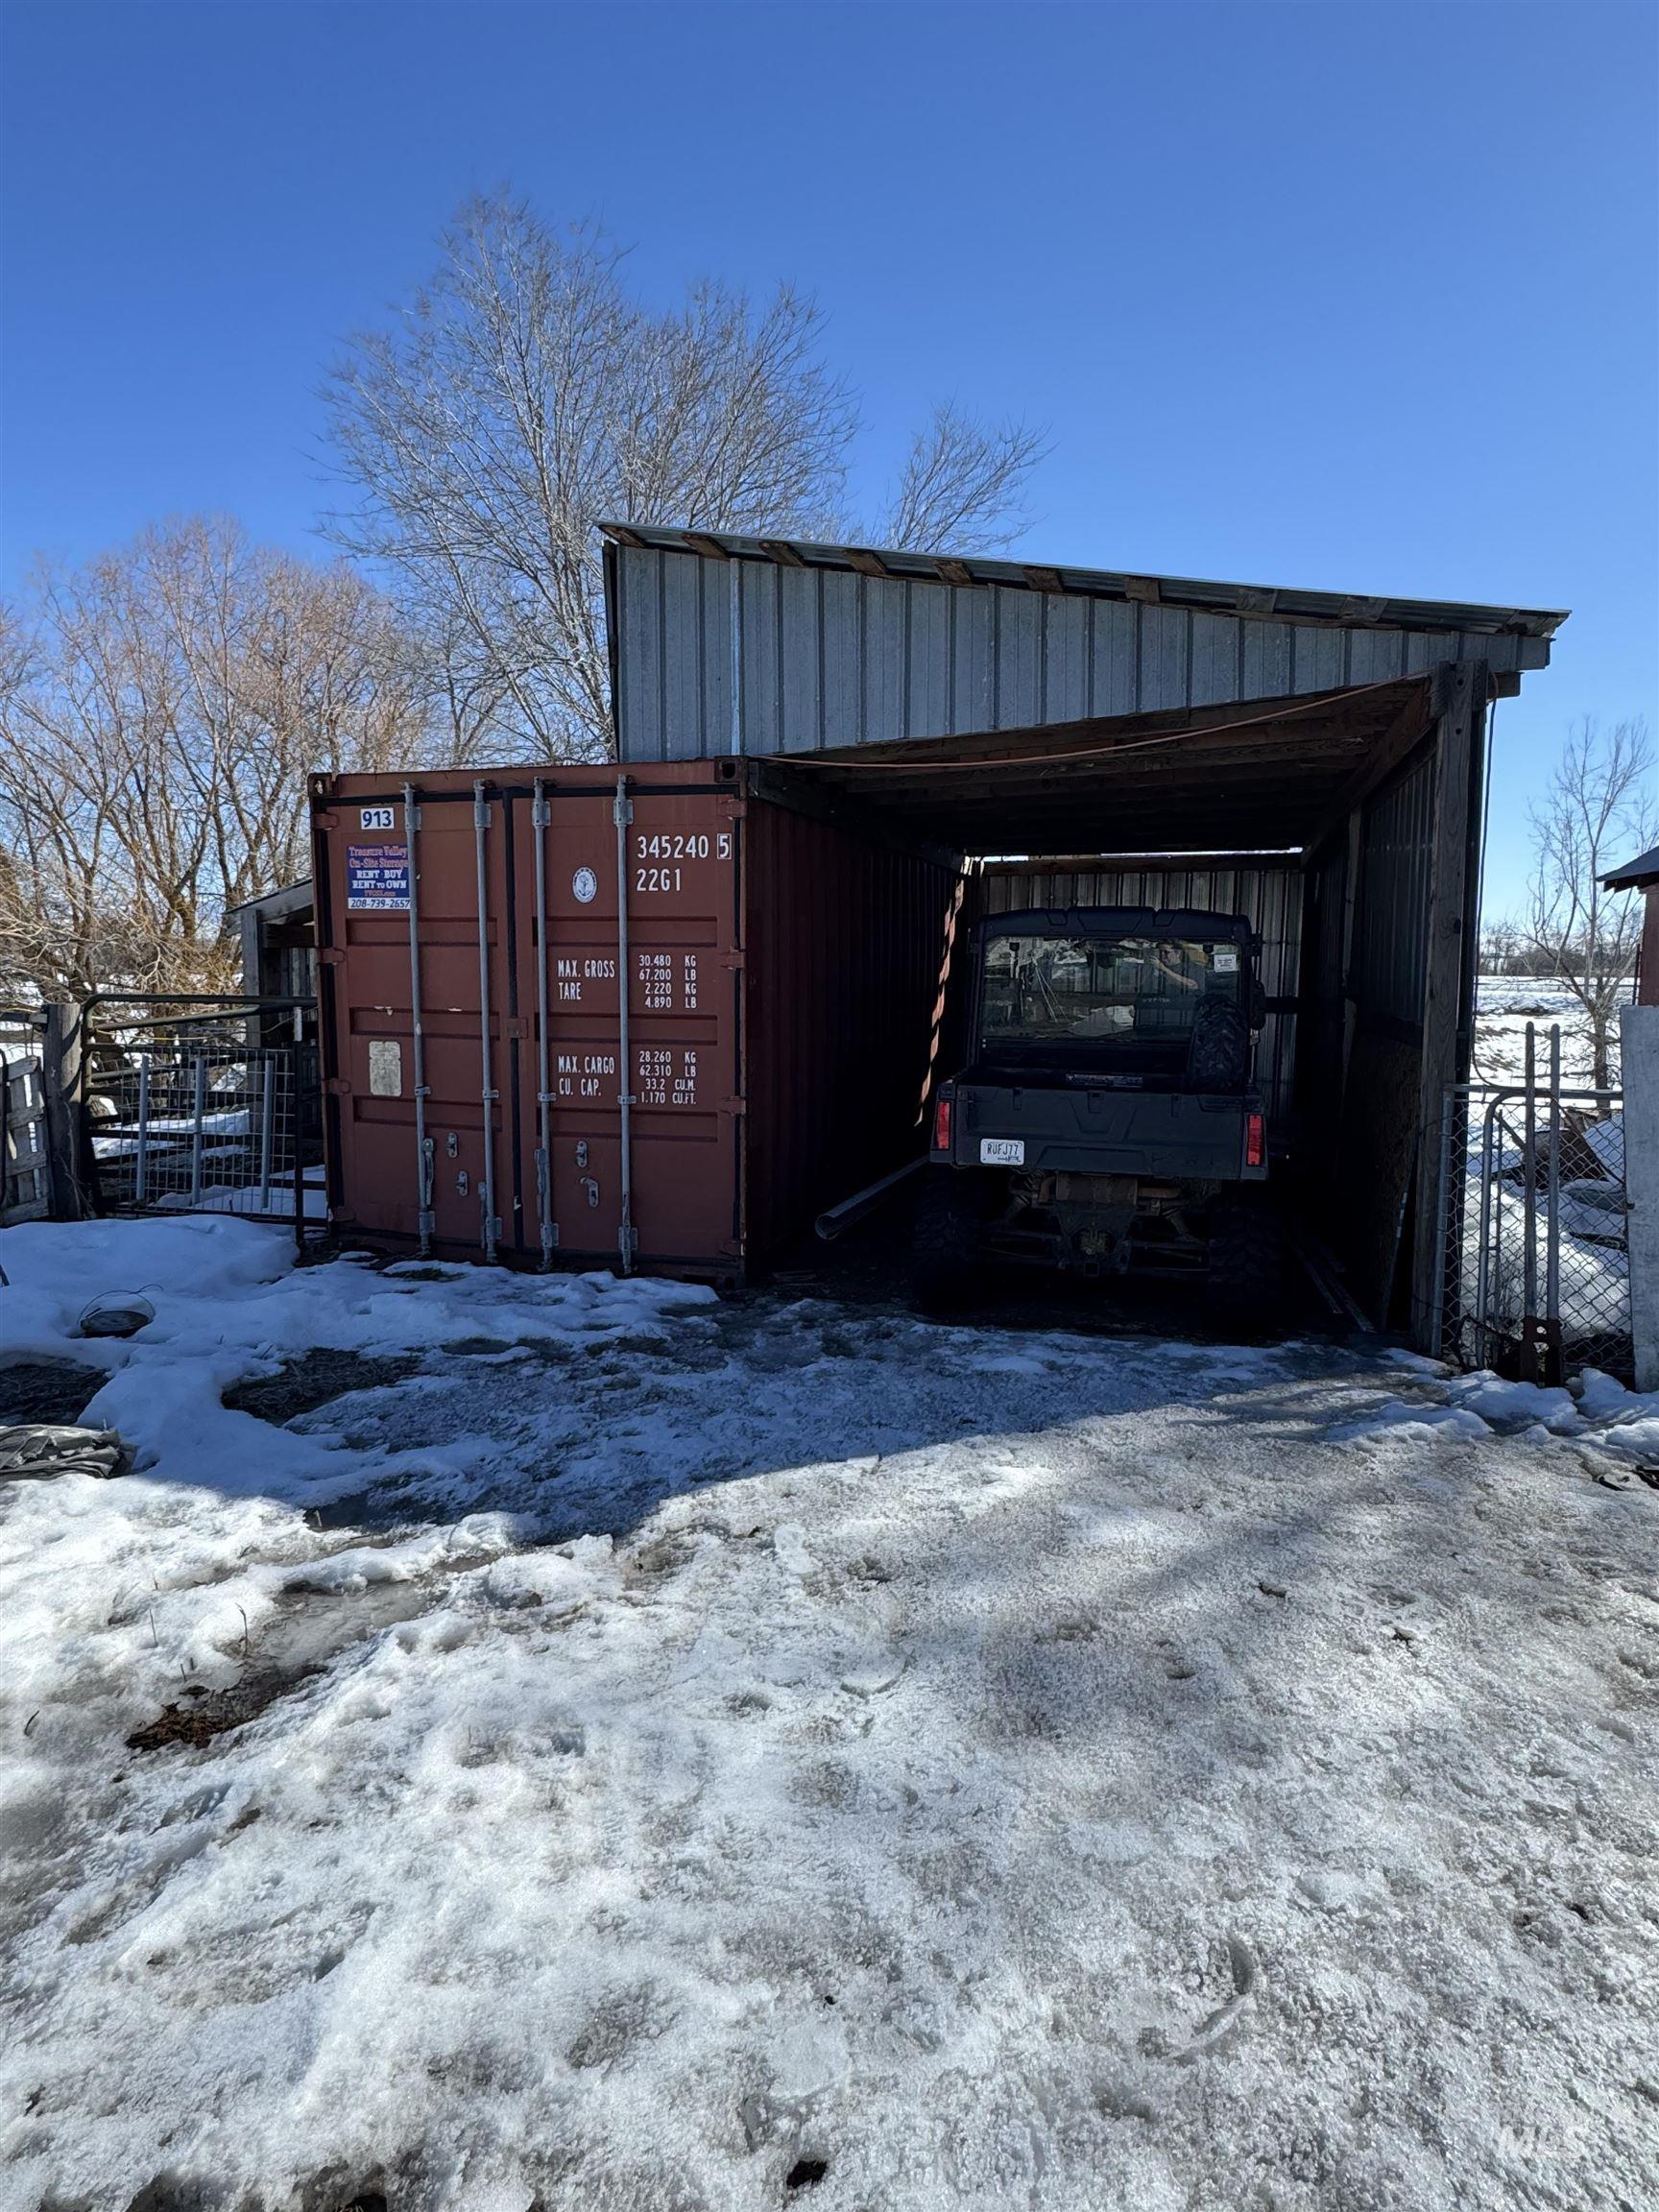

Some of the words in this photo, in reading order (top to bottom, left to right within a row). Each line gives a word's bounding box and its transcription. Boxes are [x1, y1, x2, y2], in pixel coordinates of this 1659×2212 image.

[363, 810, 393, 828] 913
[383, 846, 407, 858] Valley
[637, 835, 709, 858] 345240
[719, 835, 730, 857] 5
[356, 870, 380, 878] RENT
[384, 870, 403, 878] BUY
[637, 868, 681, 891] 22G1
[351, 880, 376, 889] RENT
[386, 880, 407, 889] OWN
[350, 899, 411, 908] 208-739-2657
[638, 955, 671, 967] 30.480
[685, 955, 696, 967] KG
[558, 960, 581, 977] MAX.
[585, 960, 615, 977] GROSS
[638, 969, 671, 980] 67.200
[685, 970, 696, 980] LB
[559, 982, 582, 1000] TARE
[645, 983, 671, 995] 2.220
[685, 983, 696, 995] KG
[645, 997, 671, 1008] 4.890
[685, 998, 696, 1008] LB
[639, 1051, 671, 1063] 28.260
[685, 1052, 696, 1063] KG
[558, 1056, 581, 1073] MAX.
[585, 1057, 614, 1074] CARGO
[639, 1065, 671, 1076] 62.310
[685, 1066, 696, 1077] LB
[559, 1078, 574, 1095] CU.
[581, 1079, 602, 1096] CAP.
[645, 1079, 665, 1091] 33.2
[640, 1092, 665, 1103] 1.170
